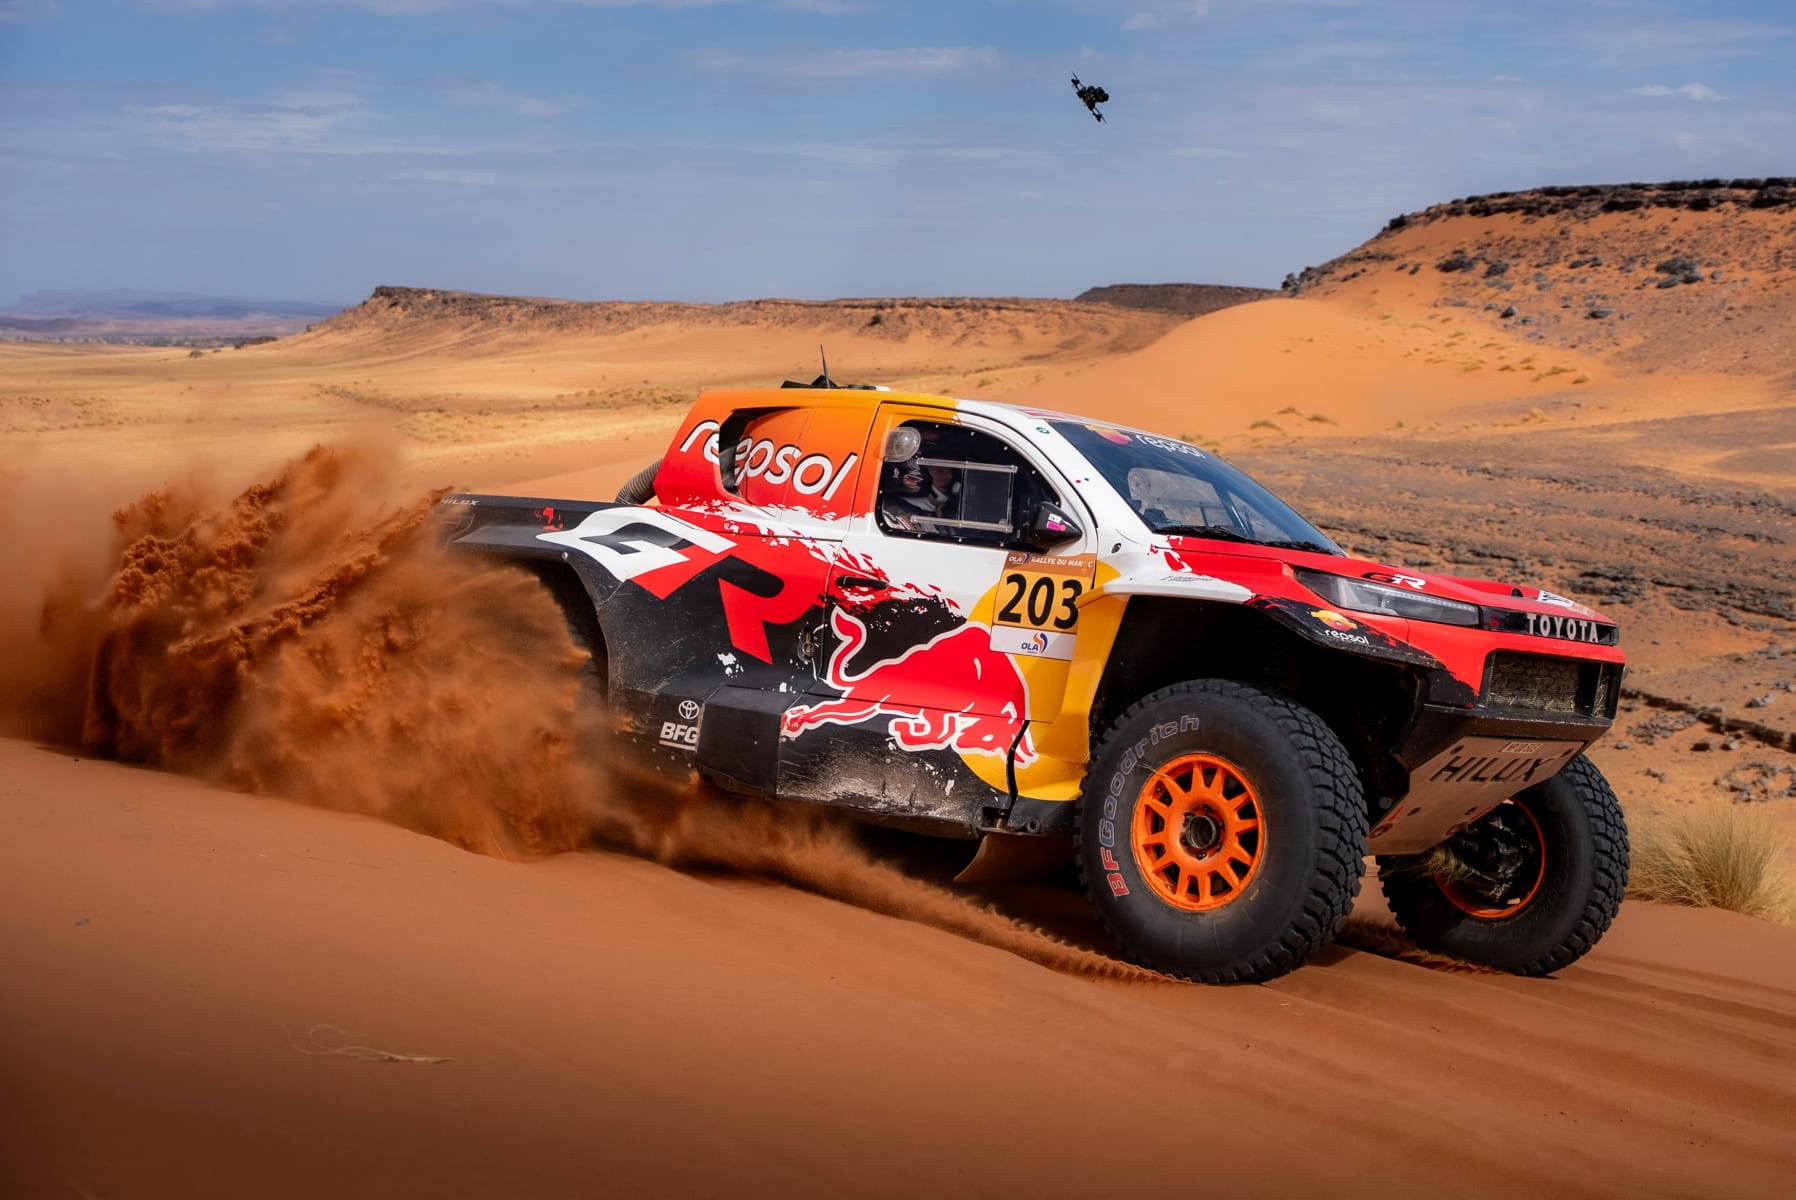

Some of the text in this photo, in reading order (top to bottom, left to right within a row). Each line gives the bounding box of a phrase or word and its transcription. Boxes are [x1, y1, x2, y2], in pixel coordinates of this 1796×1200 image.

[680, 420, 858, 501] repsol
[1031, 557, 1056, 565] RALLYE
[1067, 560, 1094, 568] MARC
[1361, 572, 1426, 590] GR
[996, 574, 1083, 630] 203
[1325, 629, 1369, 645] repsol
[1526, 613, 1599, 643] TOYOTA
[1021, 642, 1039, 651] OLA
[1428, 756, 1555, 782] HILUX
[1099, 714, 1200, 897] BFGoodrich
